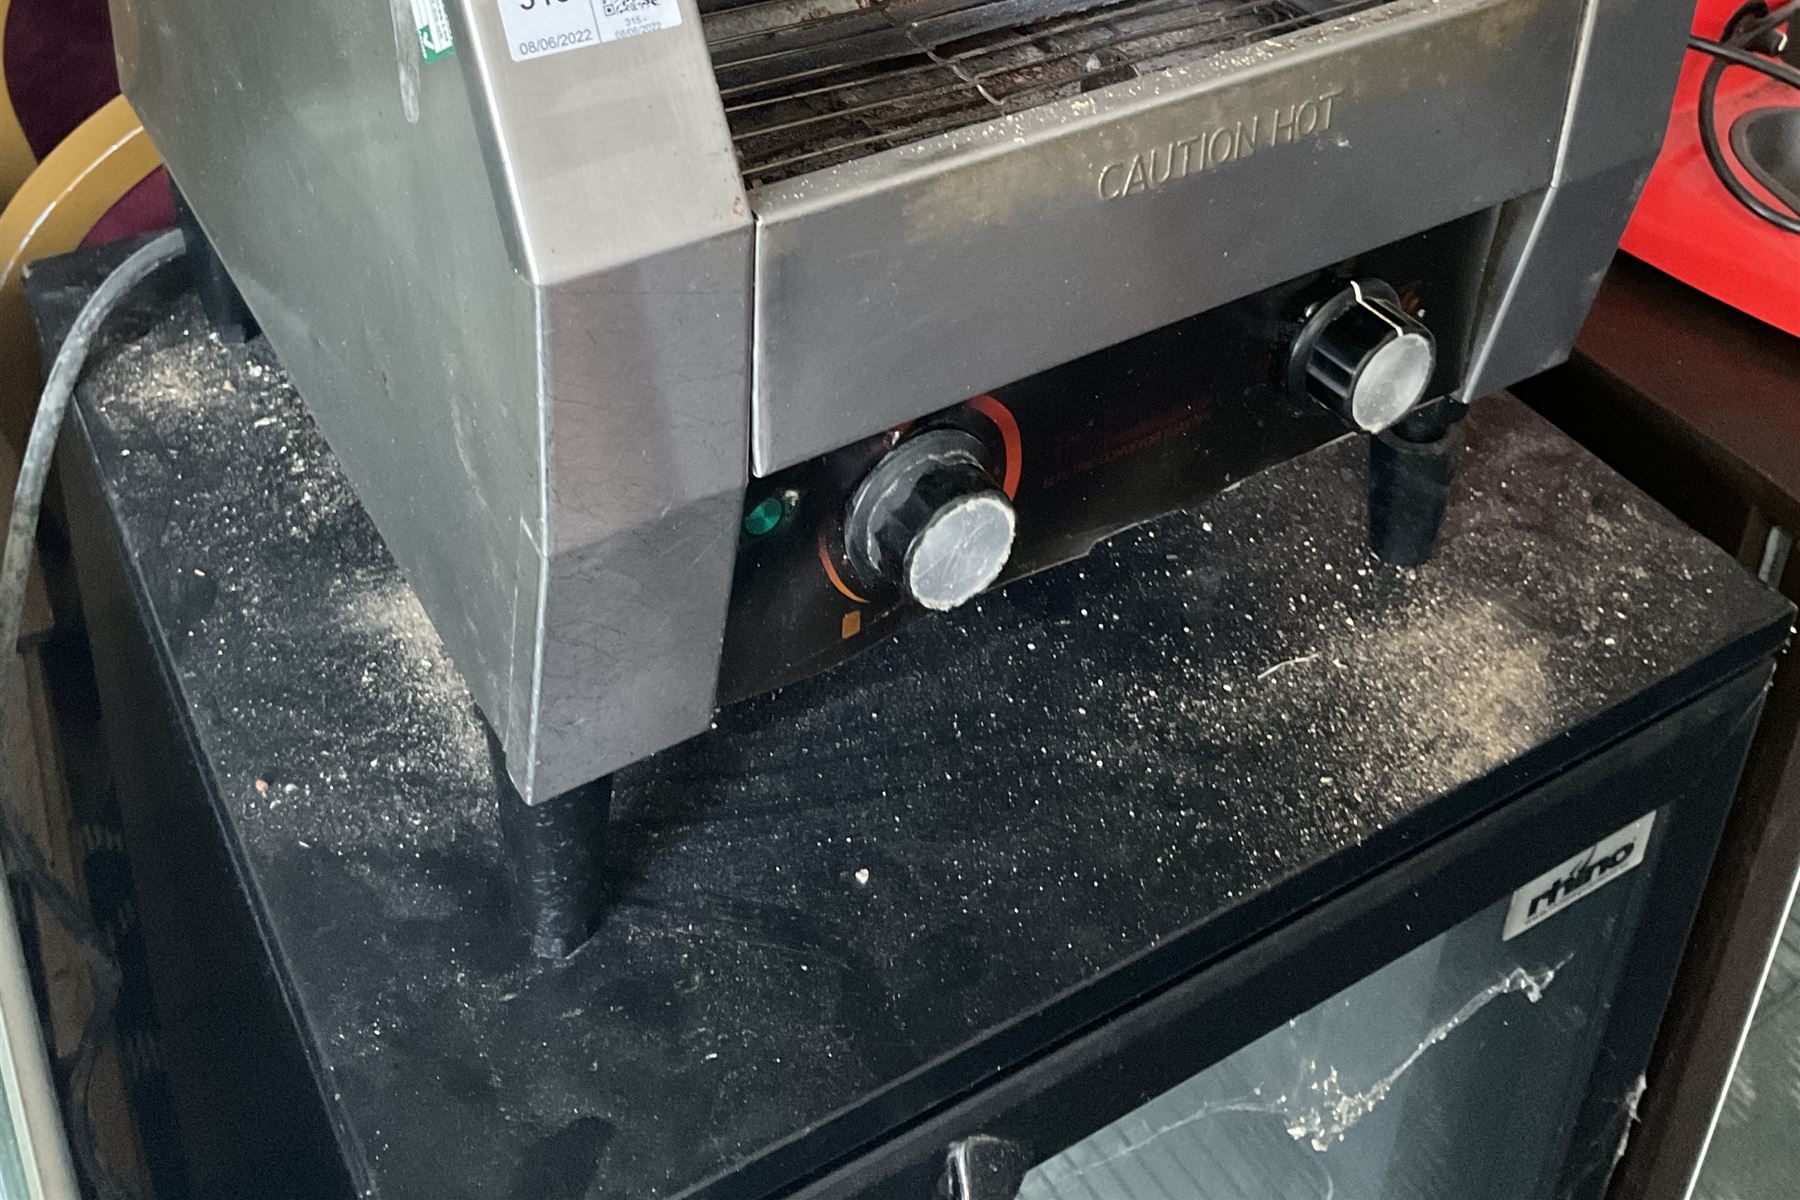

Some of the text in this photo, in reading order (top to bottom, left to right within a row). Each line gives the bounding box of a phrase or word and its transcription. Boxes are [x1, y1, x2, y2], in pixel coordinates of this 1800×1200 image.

[519, 28, 593, 56] 08/06/2022
[624, 16, 641, 27] 315
[1097, 90, 1344, 201] CAUTION HOT
[1527, 842, 1635, 918] rhino
